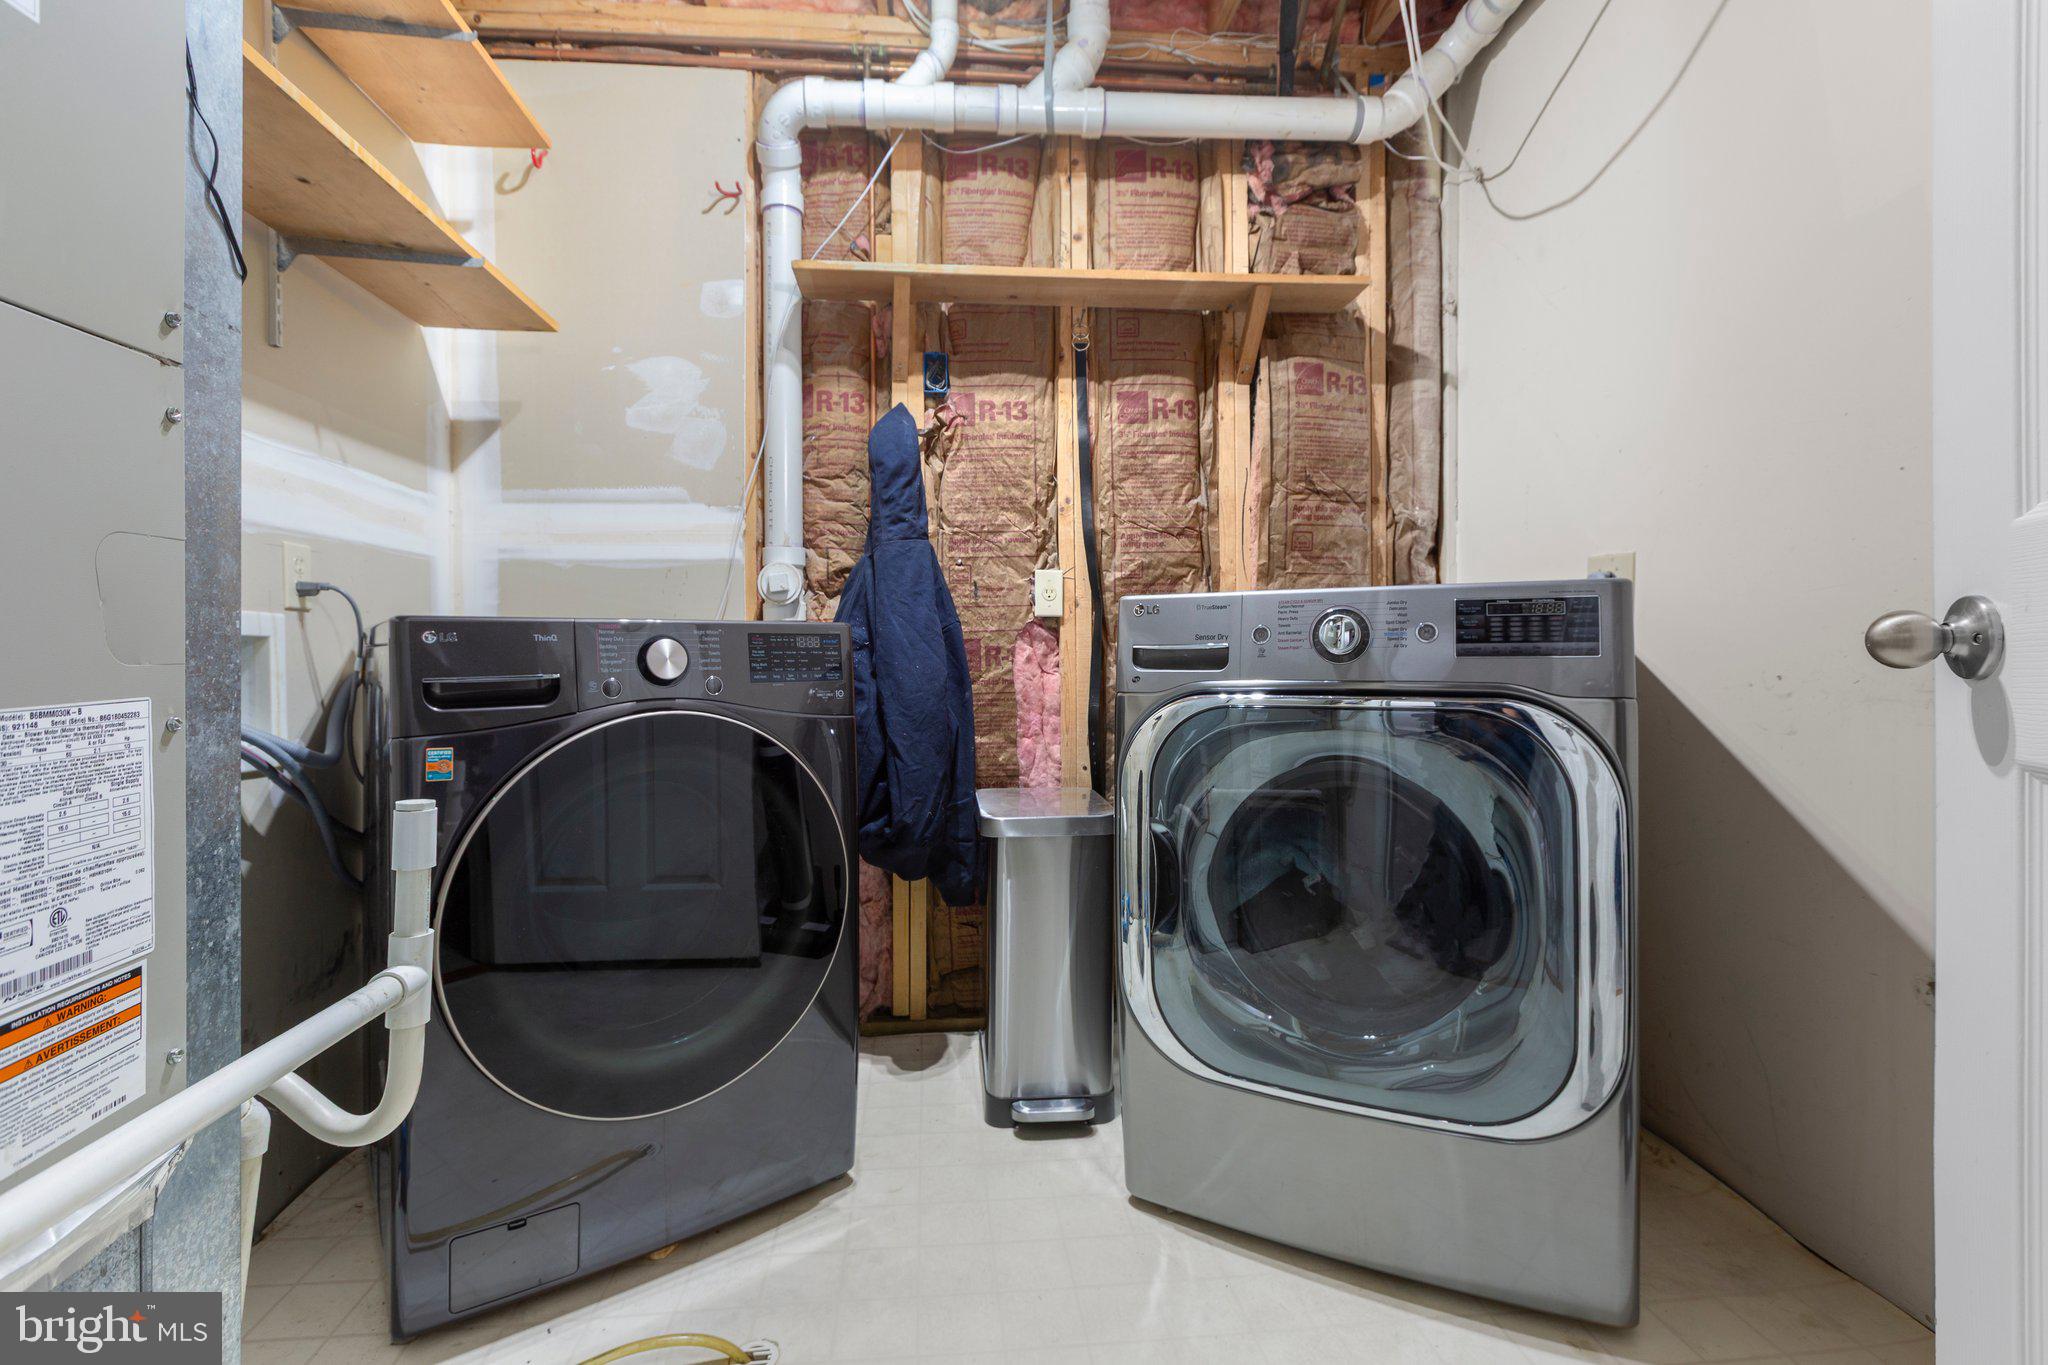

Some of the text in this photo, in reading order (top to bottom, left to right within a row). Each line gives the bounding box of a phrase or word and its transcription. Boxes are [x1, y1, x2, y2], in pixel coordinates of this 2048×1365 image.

[819, 144, 868, 168] R-13
[982, 153, 1029, 180] R-13
[1151, 156, 1196, 182] R-13
[1327, 371, 1367, 395] R-13
[816, 390, 865, 414] R-13
[978, 400, 1028, 422] R-13
[1152, 398, 1197, 421] R-13
[533, 633, 558, 642] ThinQ
[1194, 632, 1229, 642] Sensor Dry
[11, 972, 132, 1029] INSTALLATION REQUIREMENTS AND NOTES
[56, 993, 107, 1022] WARNING:
[35, 1016, 121, 1065] AVERTISSEMENT:
